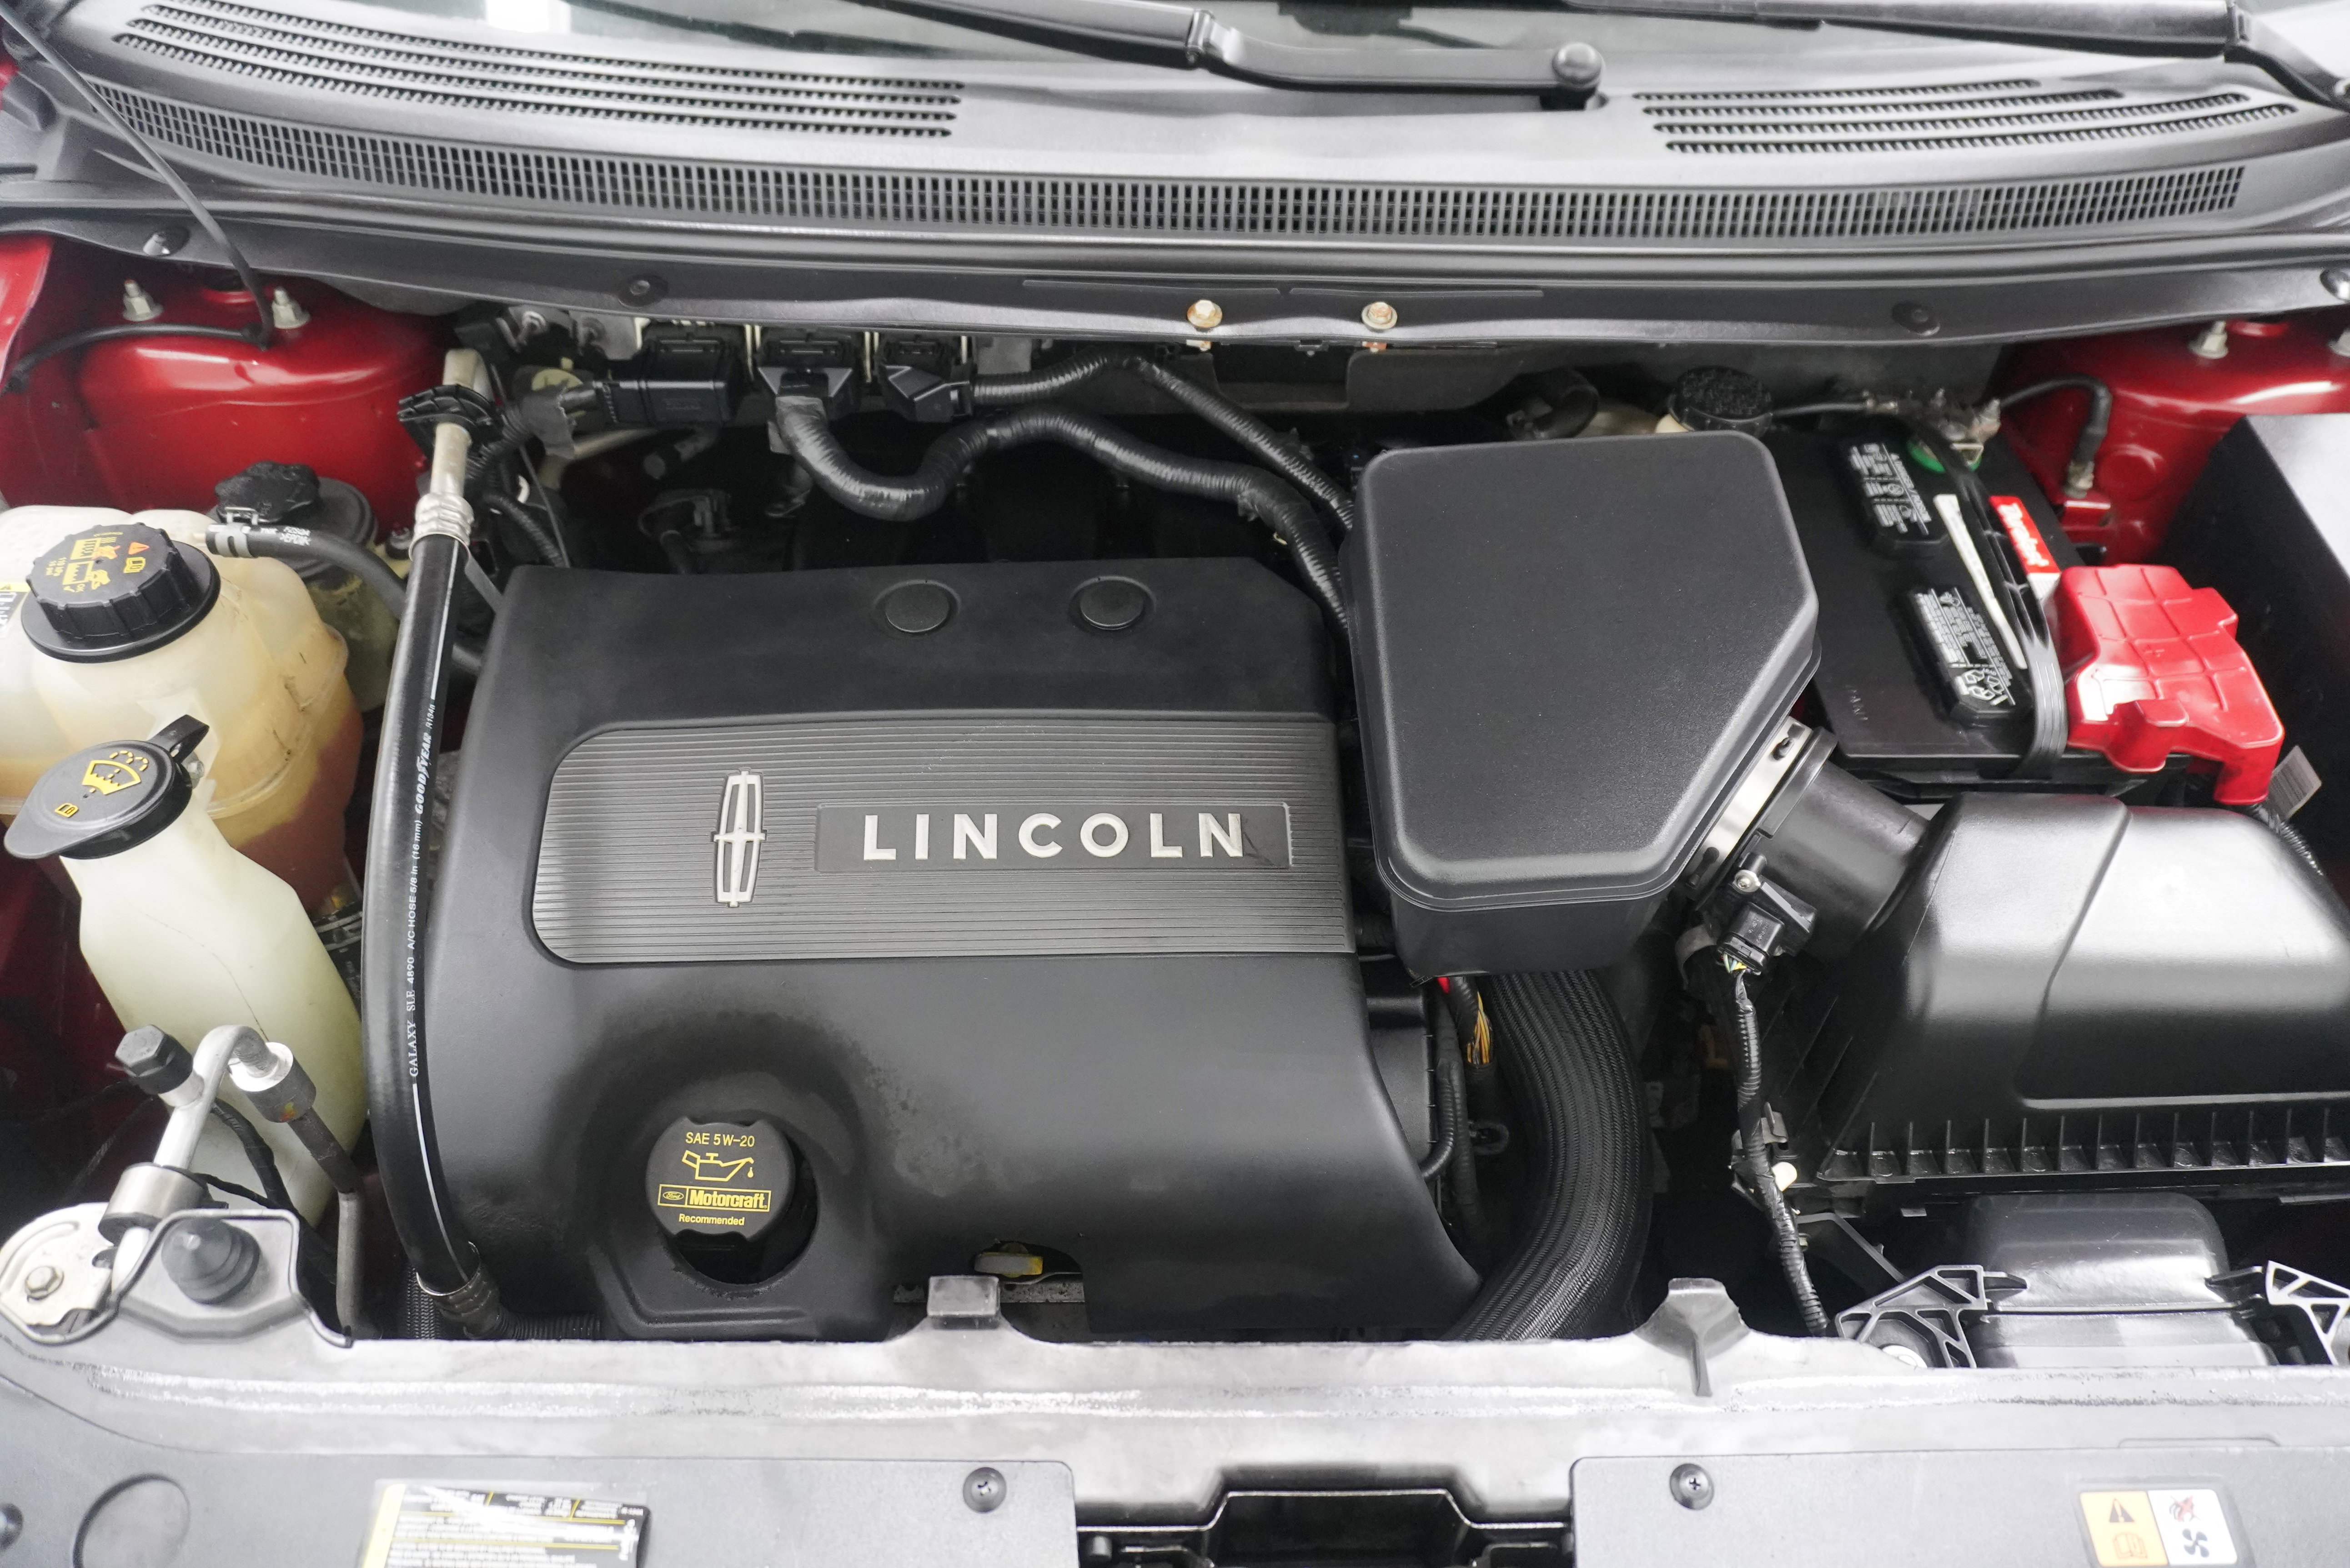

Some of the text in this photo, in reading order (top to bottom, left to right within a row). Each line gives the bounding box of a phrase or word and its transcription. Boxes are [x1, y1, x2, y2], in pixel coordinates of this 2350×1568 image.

[426, 704, 435, 729] R134a
[415, 732, 432, 814] GOODYEAR
[415, 820, 423, 842] mm)
[863, 813, 1244, 860] LINCOLN
[412, 844, 421, 860] (16
[411, 865, 418, 875] in
[408, 896, 417, 927] HOSE
[407, 930, 416, 950] A/C
[407, 956, 415, 984] 4890
[406, 990, 416, 1011] SLE
[407, 1020, 418, 1077] GALAXY
[685, 1132, 709, 1145] SAE
[689, 1190, 766, 1209] Motorcraft
[678, 1213, 745, 1226] Recommended
